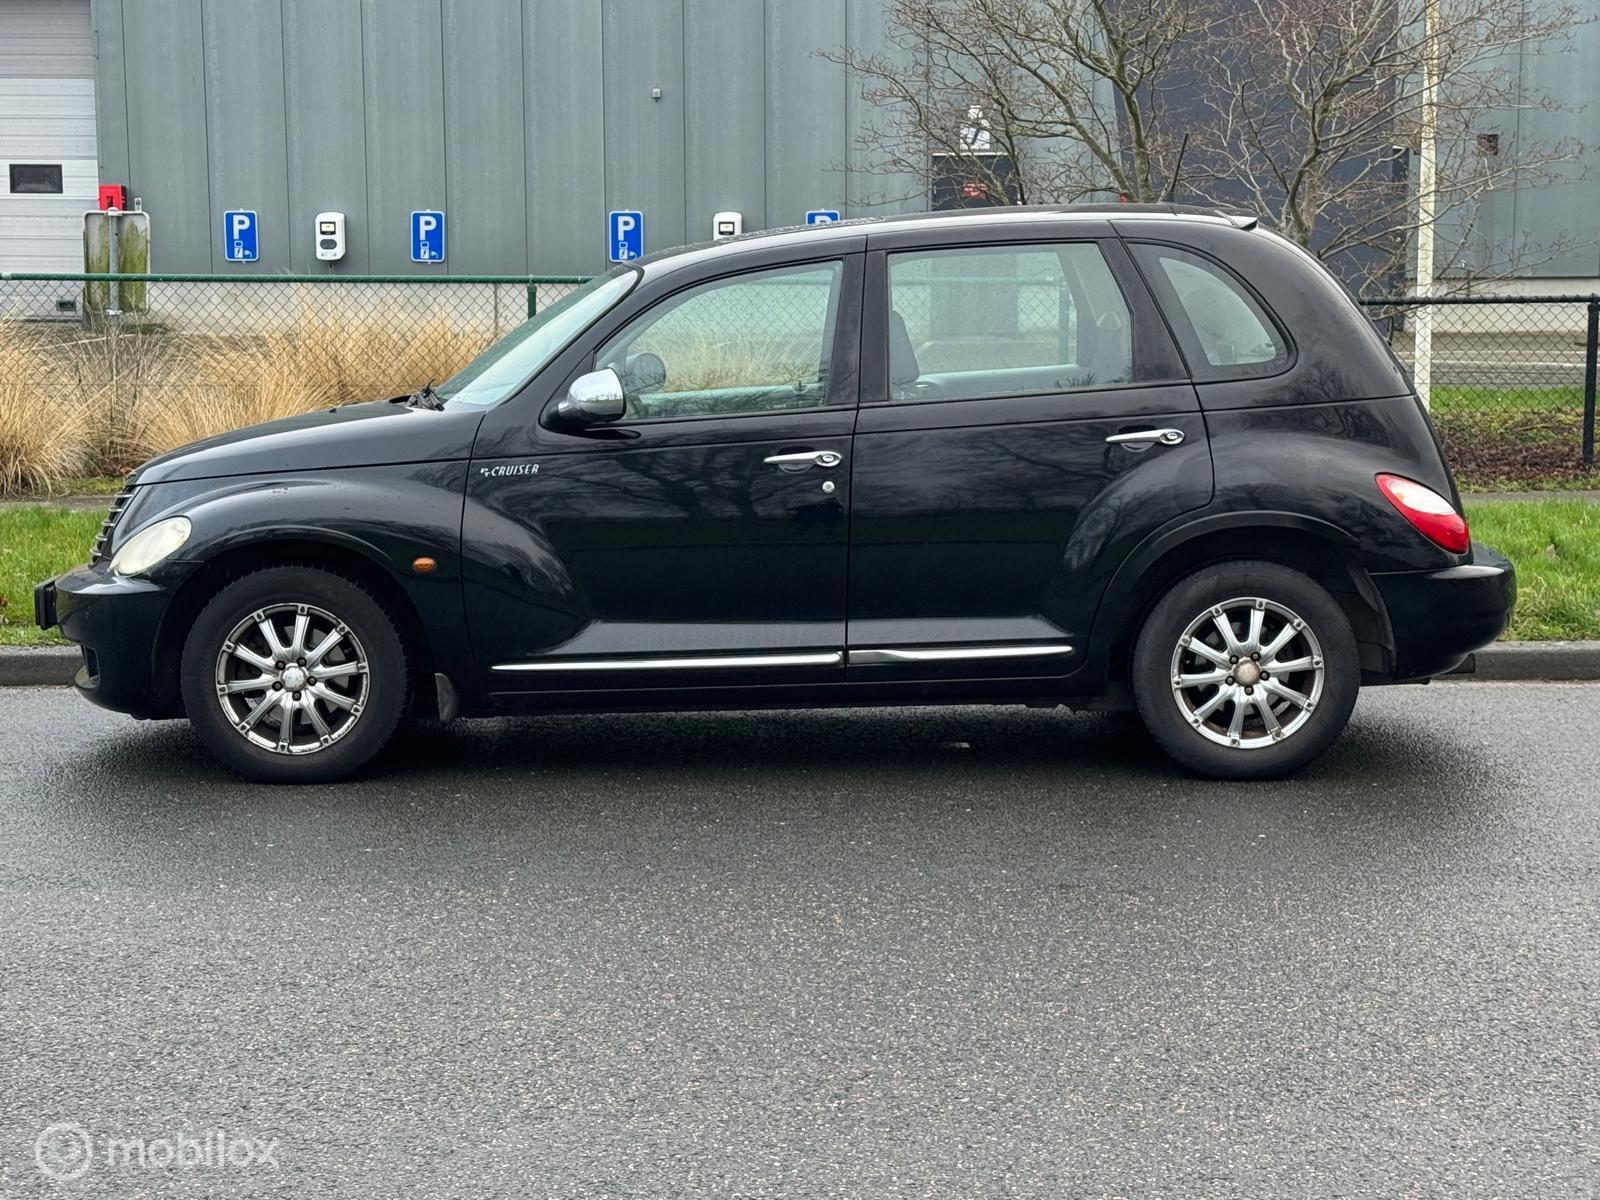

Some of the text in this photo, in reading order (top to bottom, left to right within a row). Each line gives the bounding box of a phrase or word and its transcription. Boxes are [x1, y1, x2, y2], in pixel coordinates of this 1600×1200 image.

[233, 214, 250, 240] P
[419, 215, 437, 241] P
[617, 215, 636, 241] P
[491, 463, 540, 476] CRUISER
